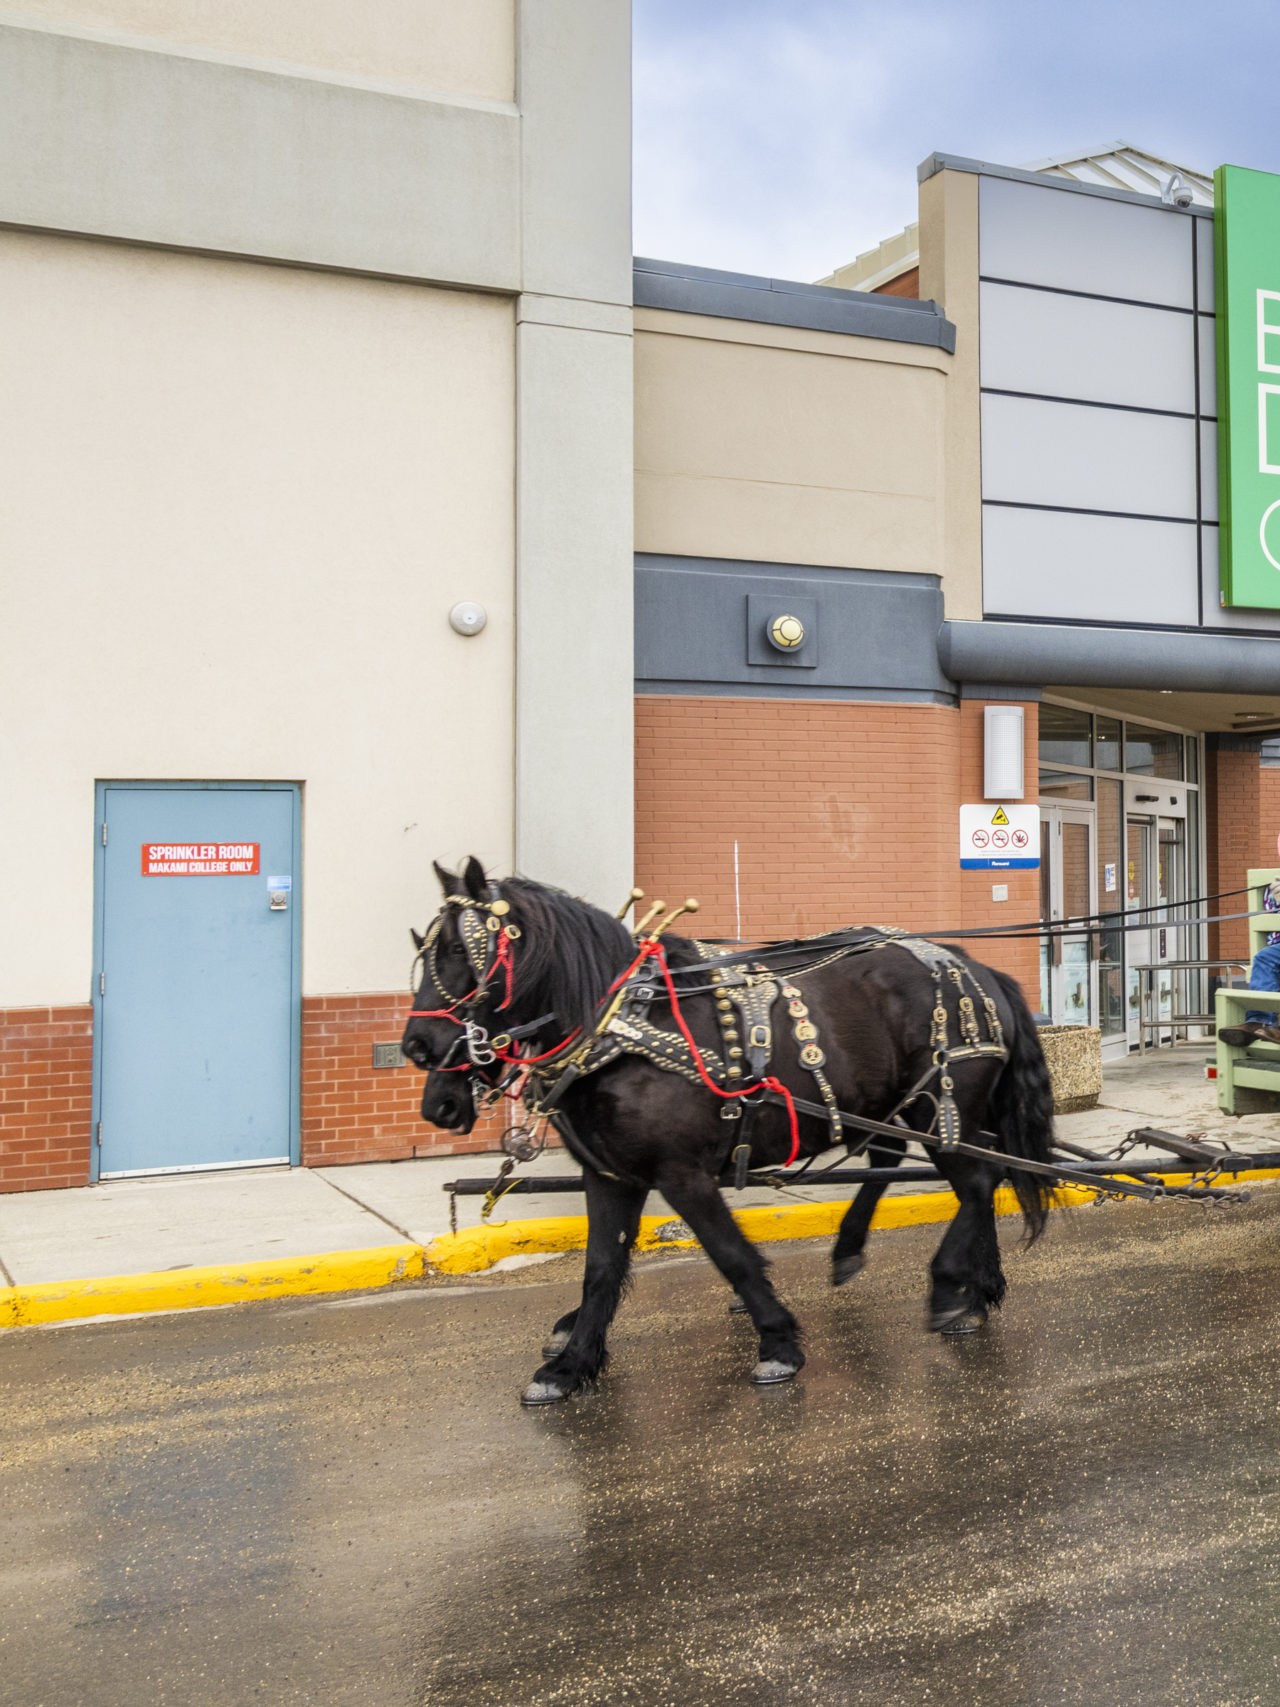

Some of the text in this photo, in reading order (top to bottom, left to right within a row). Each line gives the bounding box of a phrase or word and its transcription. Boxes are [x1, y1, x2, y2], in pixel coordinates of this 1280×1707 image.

[148, 845, 254, 860] SPRINKLER ROOM
[148, 861, 253, 873] MAKAMI COLLEGE ONLY
